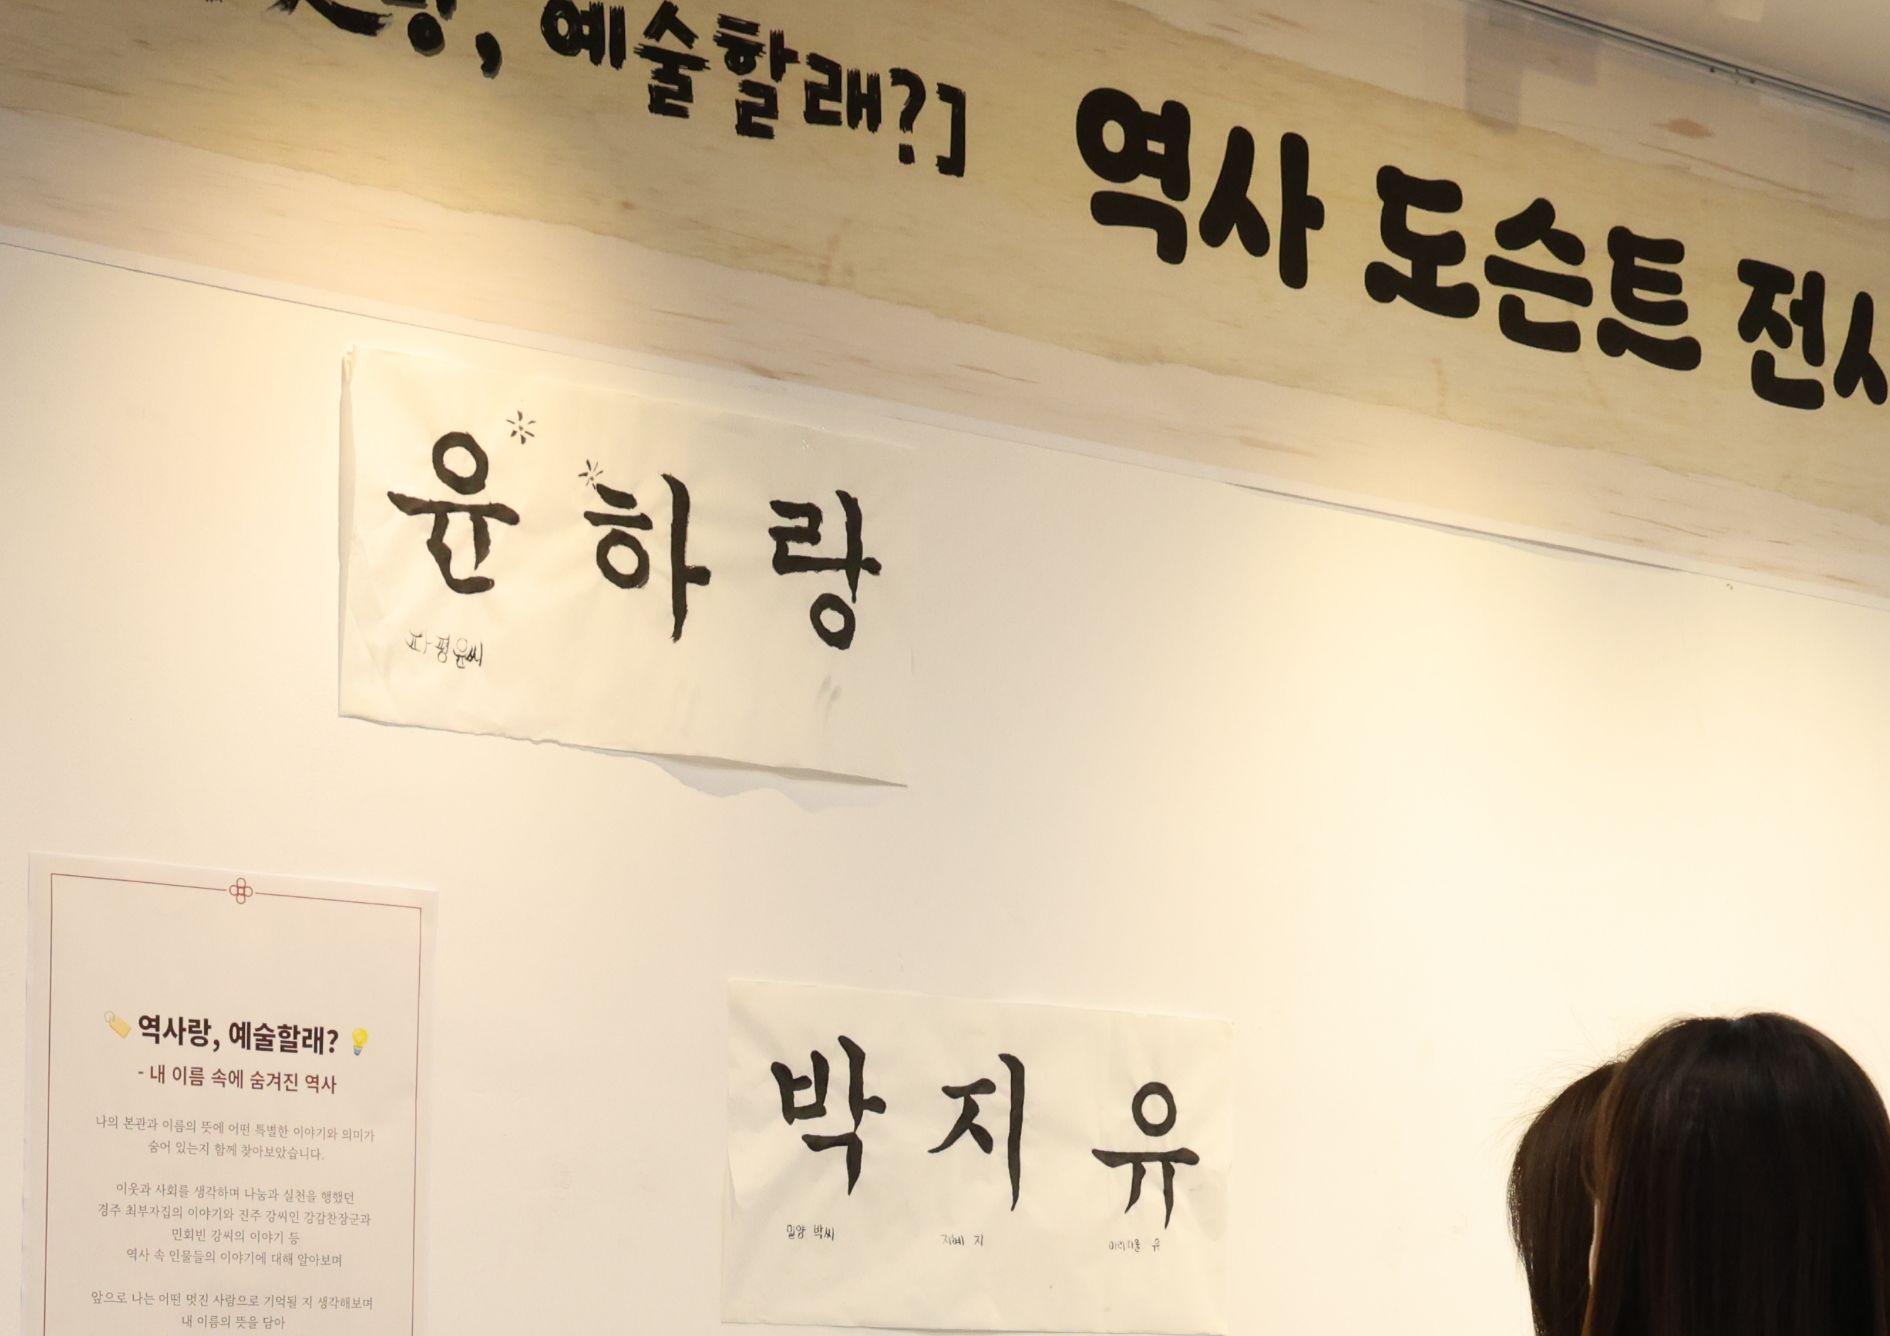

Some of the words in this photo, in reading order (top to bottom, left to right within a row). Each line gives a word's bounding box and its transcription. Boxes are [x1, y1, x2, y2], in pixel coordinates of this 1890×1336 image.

[541, 0, 966, 178] 예술할래?]
[1076, 87, 1325, 289] 역사
[1364, 165, 1702, 371] 도슨트
[138, 1014, 220, 1052] 역사랑,
[228, 1021, 339, 1055] 예술할래?
[150, 1065, 165, 1084] 내
[172, 1066, 205, 1086] 이름
[211, 1068, 244, 1088] 속에
[250, 1071, 298, 1092] 숨겨진
[305, 1074, 337, 1094] 역사
[96, 1115, 118, 1129] 나의
[123, 1116, 158, 1131] 본관과
[162, 1118, 196, 1133] 이름의
[201, 1120, 224, 1134] 뜻에
[228, 1122, 250, 1136] 어떤
[255, 1123, 288, 1138] 특별한
[293, 1125, 338, 1140] 이야기와
[341, 1127, 375, 1142] 의미가
[148, 1140, 171, 1154] 숨어
[175, 1141, 209, 1156] 있는지
[215, 1142, 237, 1156] 함께
[241, 1144, 325, 1160] 찾아보았습니다.
[116, 1181, 151, 1196] 이웃과
[155, 1183, 189, 1199] 사회를
[194, 1184, 240, 1200] 생각하며
[245, 1187, 279, 1201] 나눔과
[284, 1188, 317, 1203] 실천을
[321, 1190, 354, 1205] 행했던
[98, 1202, 121, 1217] 경주
[125, 1204, 183, 1219] 최부자집의
[188, 1206, 234, 1221] 이야기와
[239, 1208, 261, 1222] 진주
[265, 1209, 299, 1224] 강씨인
[304, 1211, 371, 1226] 강감찬장군과
[171, 1228, 206, 1242] 민회빈
[211, 1229, 245, 1243] 강씨의
[250, 1230, 283, 1244] 이야기
[288, 1232, 300, 1246] 등
[813, 1223, 835, 1241] 박씨
[127, 1248, 150, 1262] 역사
[153, 1248, 165, 1263] 속
[169, 1249, 215, 1264] 인물들의
[220, 1251, 266, 1265] 이야기에
[271, 1252, 293, 1266] 대해
[297, 1253, 342, 1268] 알아보며
[91, 1290, 127, 1304] 앞으로
[132, 1291, 155, 1306] 나는
[159, 1292, 181, 1306] 어떤
[186, 1292, 209, 1307] 멋진
[213, 1292, 260, 1308] 사람으로
[264, 1294, 297, 1309] 기억될
[302, 1295, 313, 1309] 지
[318, 1295, 373, 1310] 생각해보며
[182, 1314, 193, 1328] 내
[197, 1314, 231, 1329] 이름의
[235, 1315, 259, 1329] 뜻을
[263, 1315, 286, 1330] 담아
